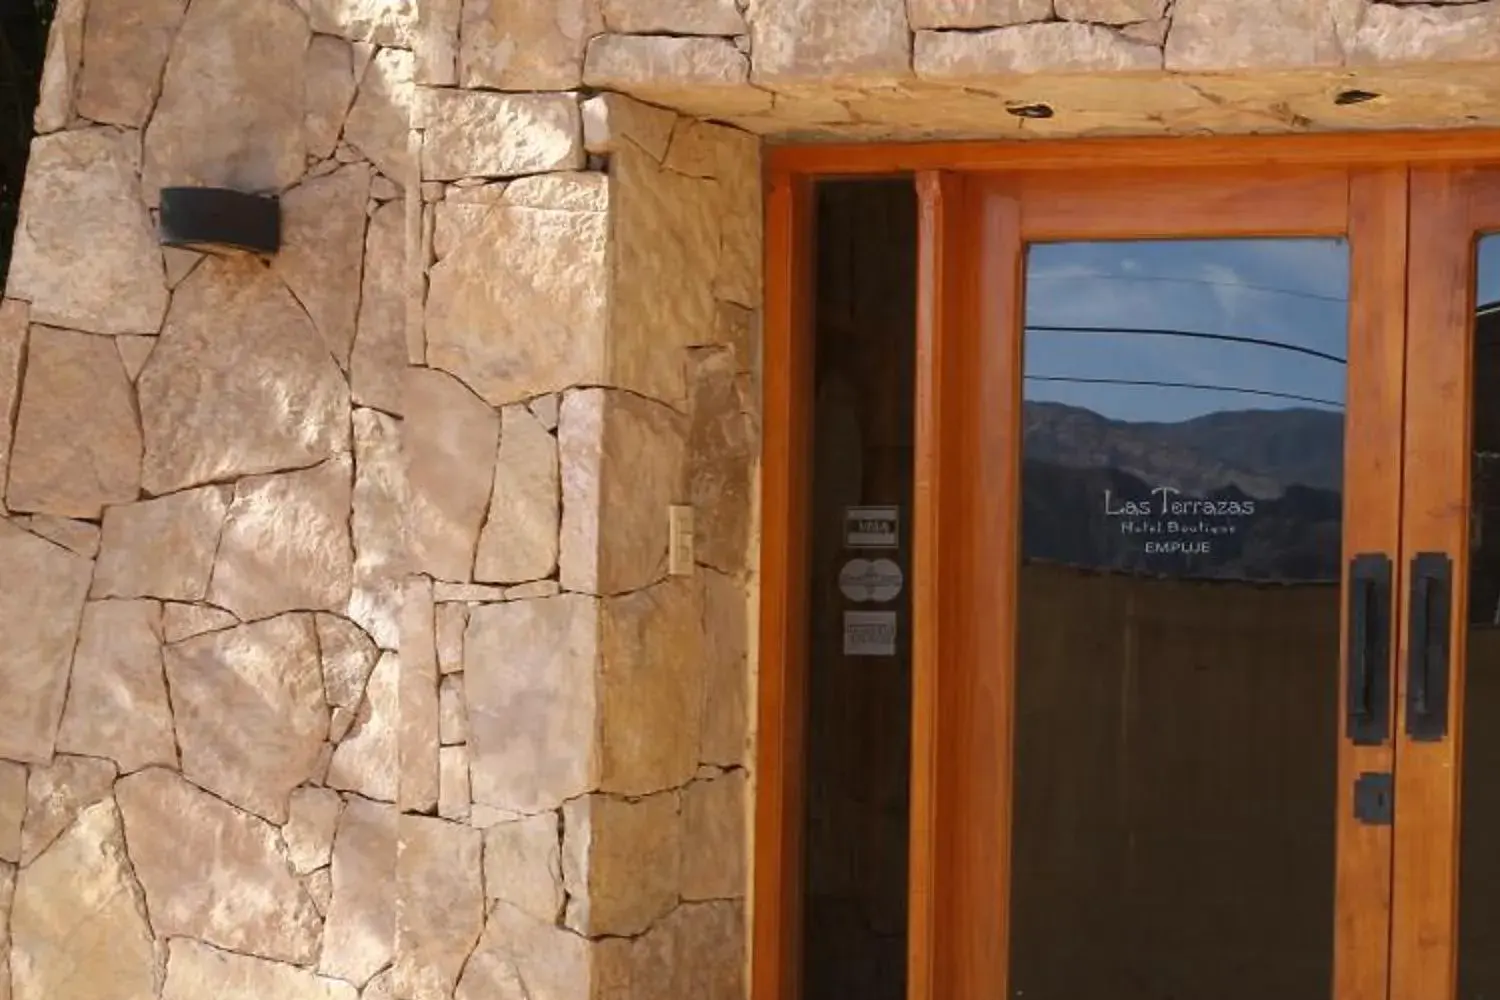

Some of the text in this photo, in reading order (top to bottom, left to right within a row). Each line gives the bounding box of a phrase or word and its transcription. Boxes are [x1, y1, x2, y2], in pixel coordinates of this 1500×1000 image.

[1104, 486, 1255, 516] Las Terrazas
[1121, 521, 1162, 534] Hotel
[1145, 541, 1211, 553] EMPUJE
